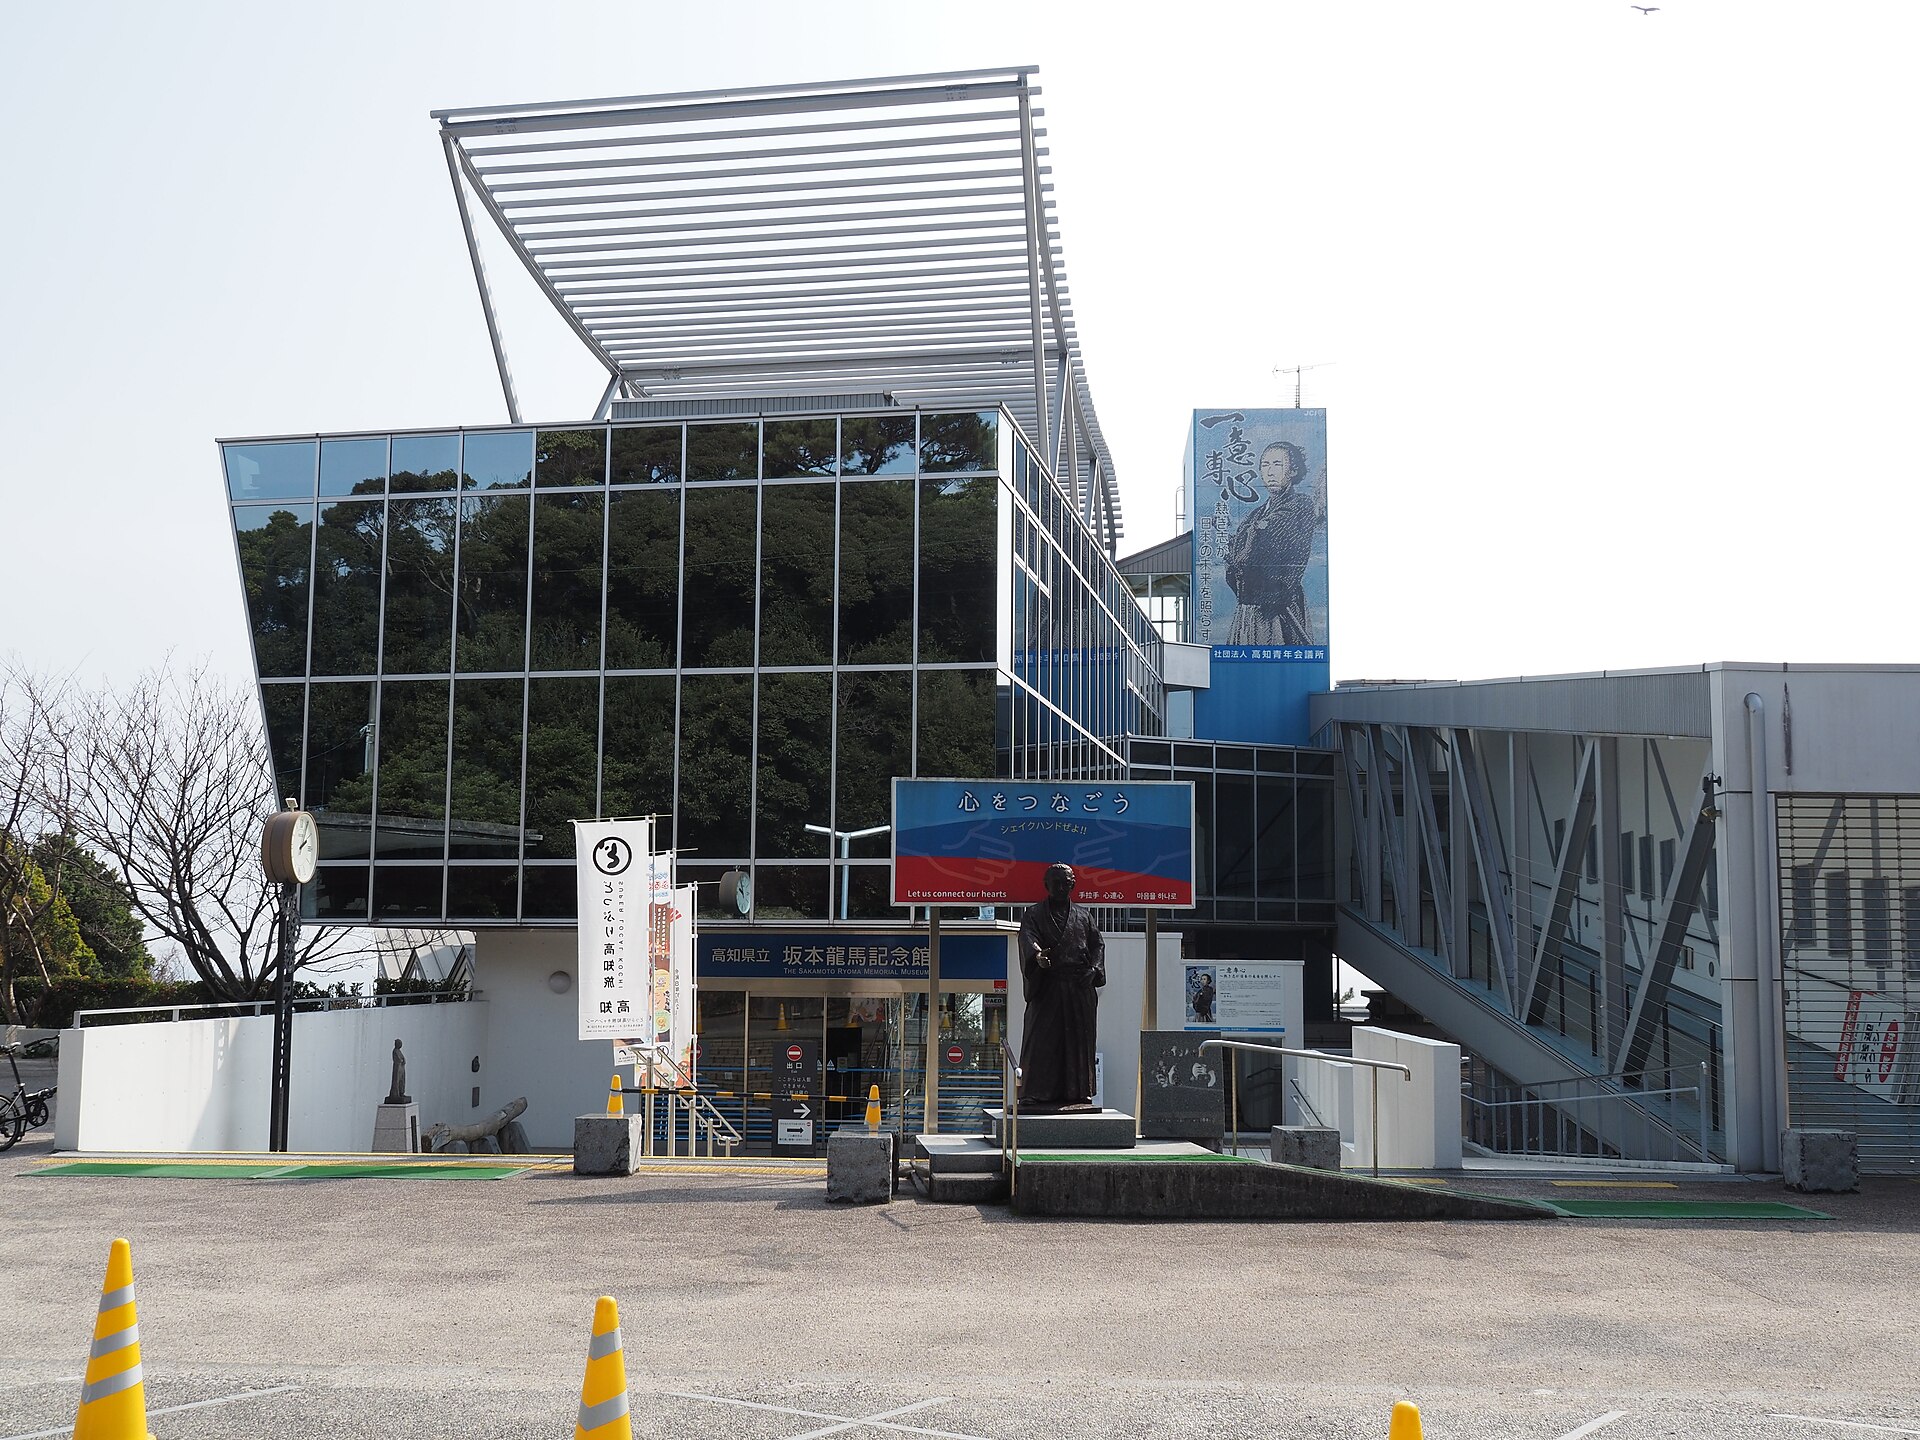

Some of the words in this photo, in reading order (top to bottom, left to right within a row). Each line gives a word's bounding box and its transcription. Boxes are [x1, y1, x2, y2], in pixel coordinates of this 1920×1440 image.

[1215, 502, 1229, 559] 熱き志が
[1200, 517, 1212, 641] 日本の未来を照らす
[1214, 650, 1247, 659] 社団法人
[1251, 649, 1324, 659] 高知青年会議所
[958, 791, 1129, 814] 心をつなごう
[907, 889, 920, 898] Let
[933, 889, 964, 898] connect
[981, 889, 1007, 898] hearts
[1079, 891, 1099, 899] 手拉手
[1157, 892, 1177, 900] 하나로
[712, 948, 770, 963] 高知県立
[782, 945, 929, 966] 坂本龍馬記念館
[783, 967, 797, 975] THE
[798, 967, 836, 975] SAKAMOTO
[837, 967, 862, 975] RYOMA
[863, 967, 898, 975] MEMORIAL
[900, 968, 929, 976] MUSEUM
